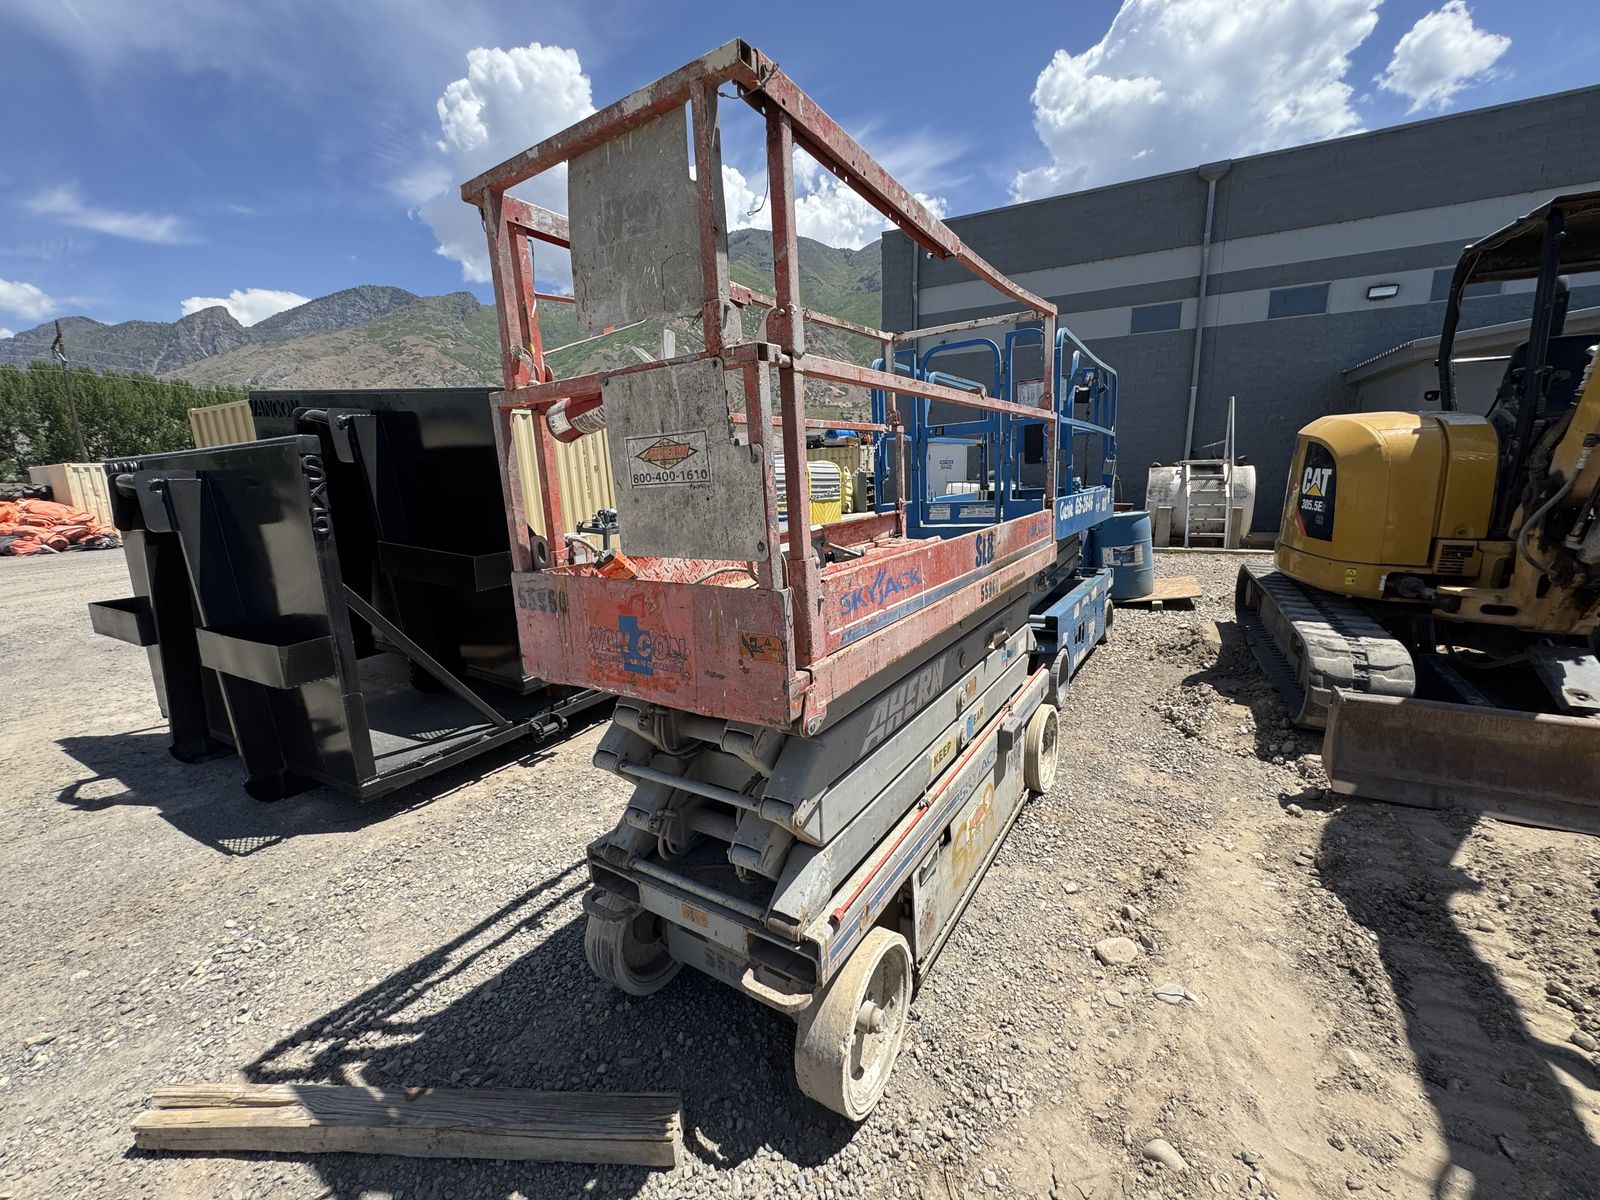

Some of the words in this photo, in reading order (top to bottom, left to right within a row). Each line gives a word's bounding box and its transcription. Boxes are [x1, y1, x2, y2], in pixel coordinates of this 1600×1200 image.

[632, 468, 708, 484] 800-400-1610
[1302, 466, 1332, 497] CAT
[859, 656, 947, 757] AHERN
[933, 741, 952, 768] KEEP
